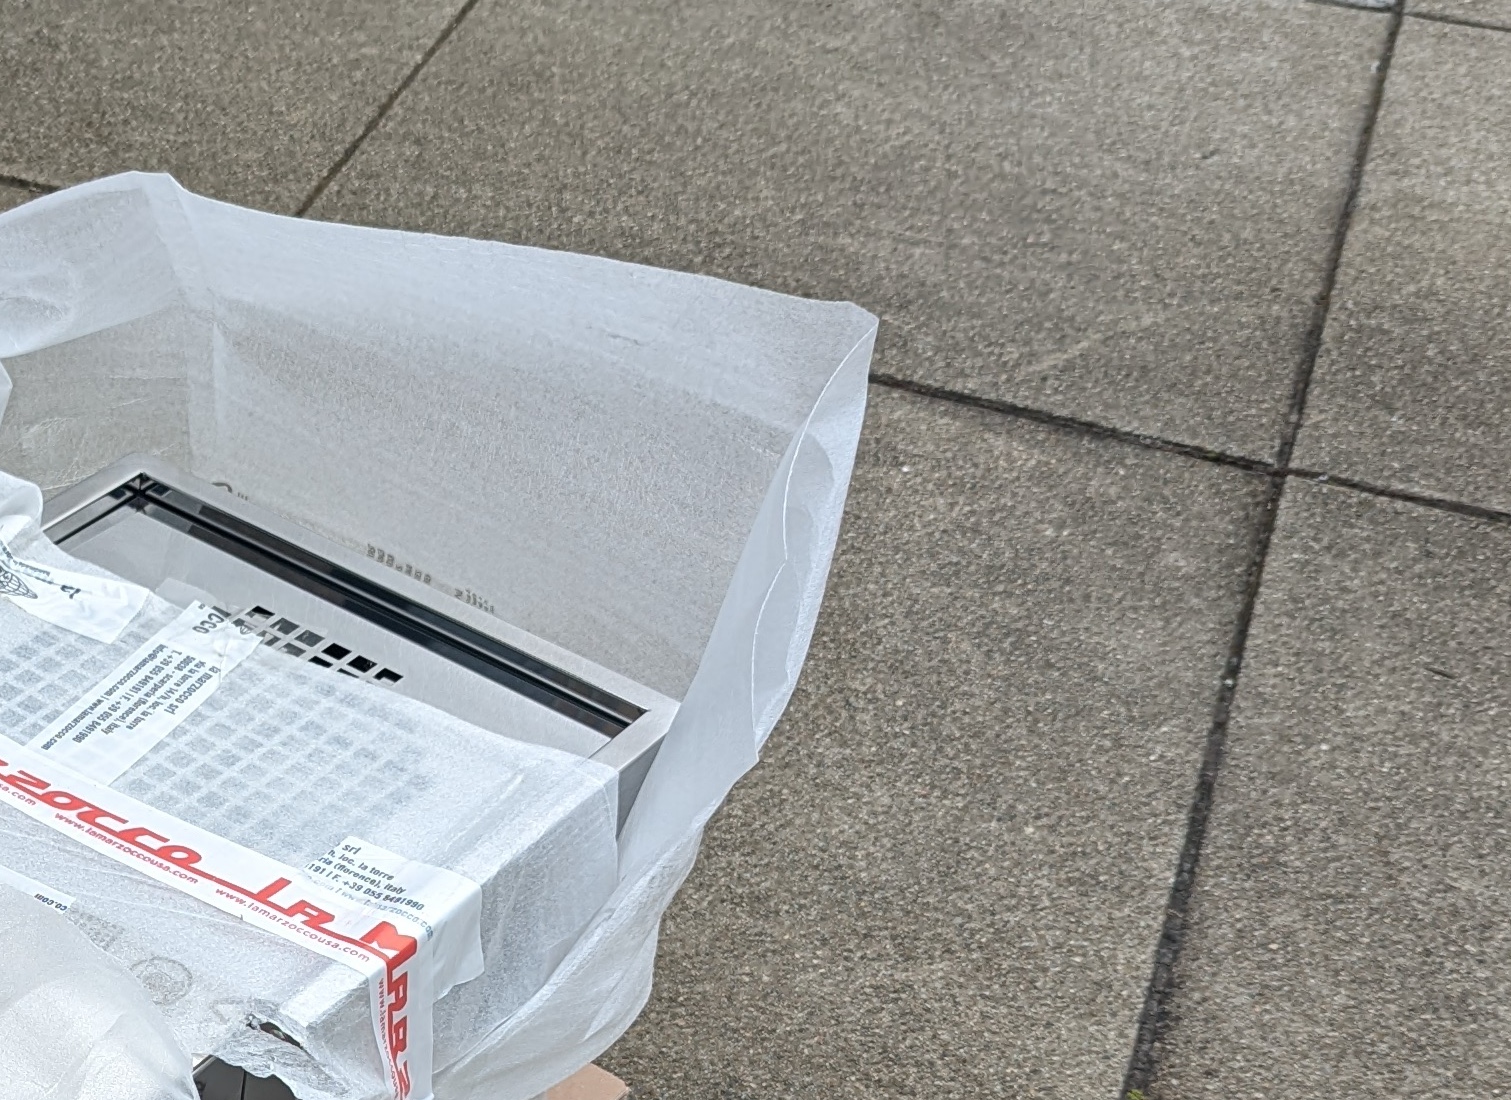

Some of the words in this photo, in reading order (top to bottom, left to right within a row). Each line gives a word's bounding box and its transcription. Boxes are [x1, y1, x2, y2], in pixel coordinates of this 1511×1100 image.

[174, 671, 213, 704] marzocco
[163, 702, 179, 715] srl
[55, 812, 199, 884] www.lamarzoccousa.com
[341, 843, 362, 855] srl
[368, 866, 394, 880] torre
[342, 881, 363, 891] +39
[362, 887, 383, 899] 055
[215, 889, 370, 962] www.lamarzoccousa.com
